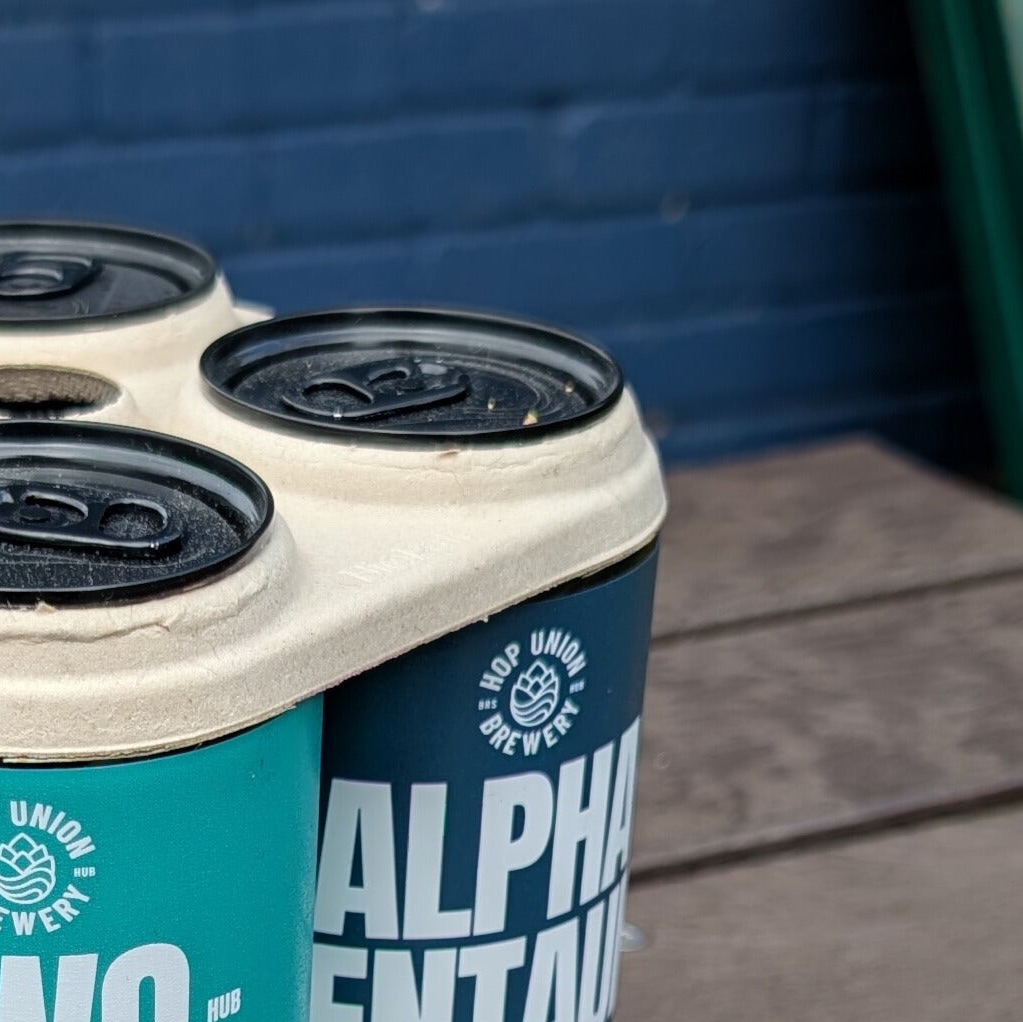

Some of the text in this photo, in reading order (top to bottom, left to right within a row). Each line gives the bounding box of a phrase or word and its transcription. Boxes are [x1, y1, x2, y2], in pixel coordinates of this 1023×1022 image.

[479, 628, 587, 692] HOP UNION
[479, 699, 580, 757] BREWERY
[10, 800, 97, 860] UNION
[313, 715, 641, 940] ALPHA
[73, 866, 96, 878] HUB
